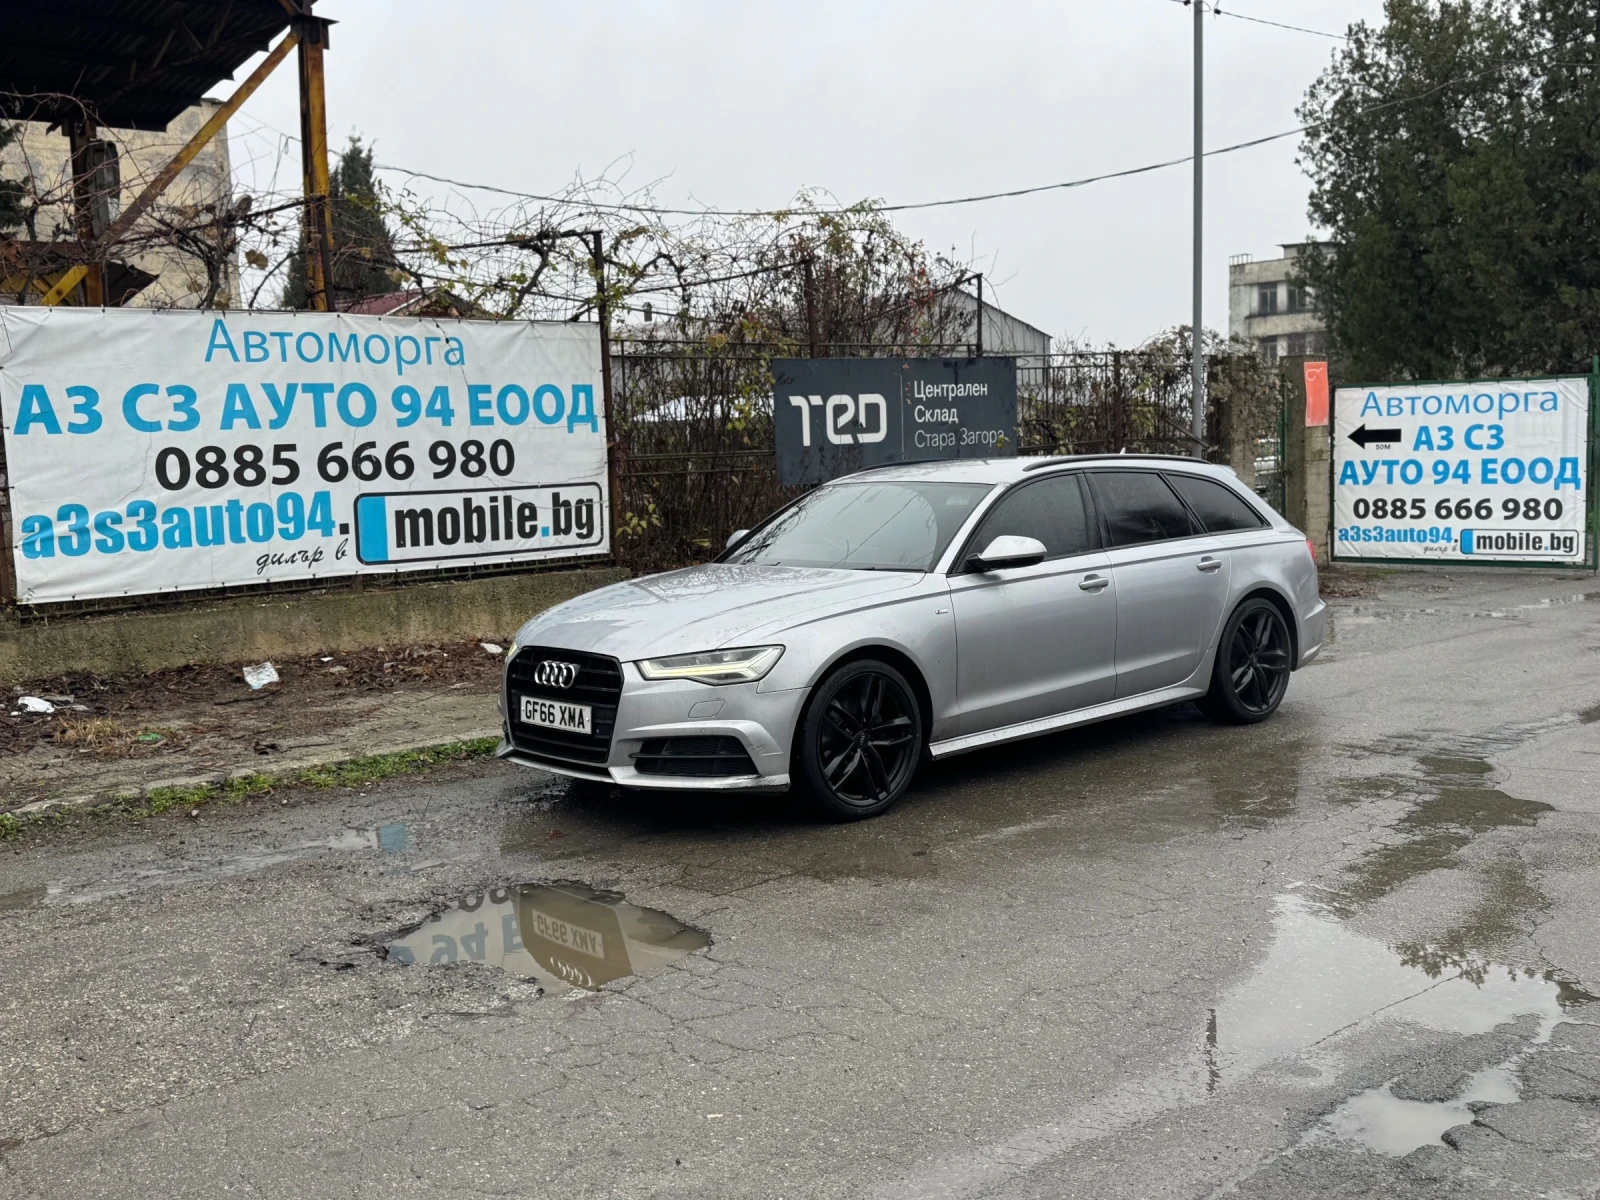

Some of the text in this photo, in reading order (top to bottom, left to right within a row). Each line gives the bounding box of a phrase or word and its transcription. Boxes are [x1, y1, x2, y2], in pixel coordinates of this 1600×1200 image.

[204, 319, 465, 376] Автоморга
[913, 380, 988, 403] Централен
[1360, 390, 1559, 420] Автоморга
[13, 384, 103, 435] А3
[219, 382, 377, 431] АУТО
[391, 384, 455, 428] 94
[468, 383, 599, 434] ЕООД
[914, 405, 959, 425] Склад
[914, 429, 956, 450] Стара
[155, 438, 516, 491] 0885 666 980
[1338, 456, 1581, 491] АУТО 94 ЕООД
[394, 492, 595, 549] mobile.bg
[1353, 497, 1563, 521] 0885 666 980
[1476, 532, 1574, 554] mobile.bg
[256, 546, 325, 575] дилър
[524, 700, 585, 729] GF66 XMA
